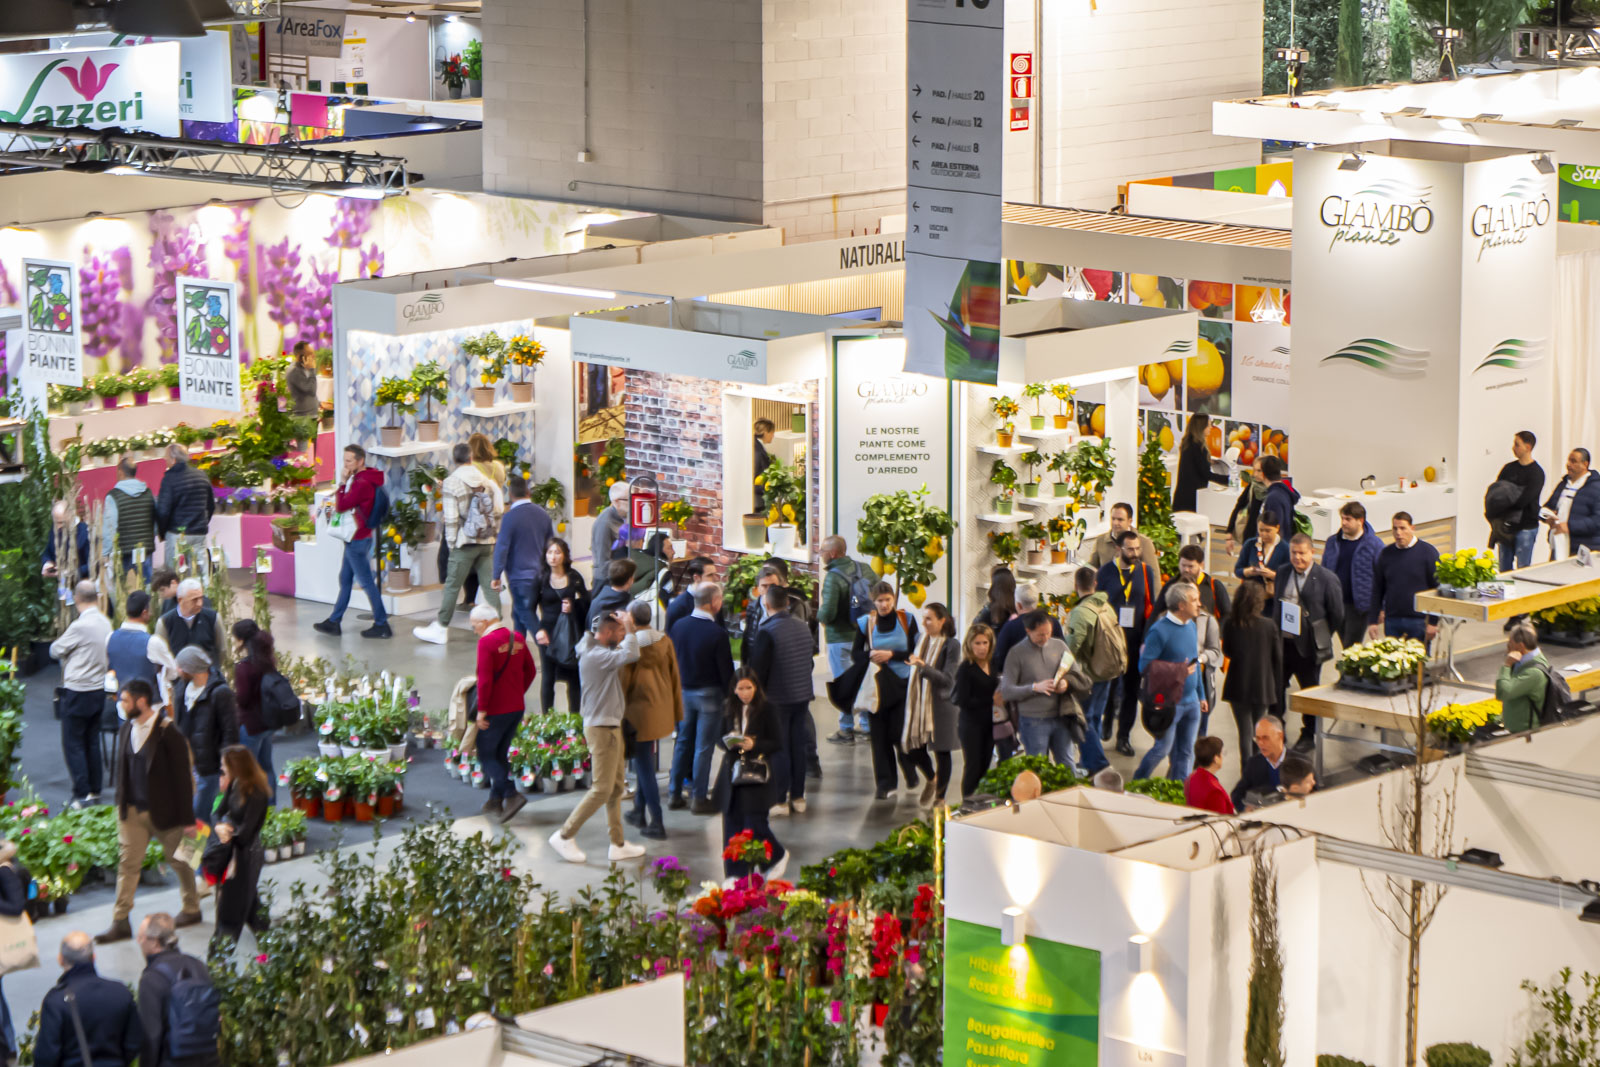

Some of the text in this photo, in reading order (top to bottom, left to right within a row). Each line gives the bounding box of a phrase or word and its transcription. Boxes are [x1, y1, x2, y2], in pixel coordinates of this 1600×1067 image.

[283, 18, 342, 38] AreaFox
[974, 90, 985, 101] 20
[973, 117, 982, 128] 12
[973, 142, 979, 153] 8
[931, 161, 979, 171] AREA ESTERNA
[930, 205, 953, 213] TOILETTE
[929, 224, 948, 232] USCITA
[1328, 227, 1400, 253] piante
[28, 334, 75, 353] BONINI
[30, 353, 75, 371] PIANTE
[185, 357, 232, 379] BONINI
[186, 377, 233, 396] PIANTE
[880, 427, 919, 435] NOSTRE
[969, 976, 999, 996] Rosa
[967, 1017, 1055, 1050] Bougainvillea
[966, 1038, 1029, 1064] Passiflora
